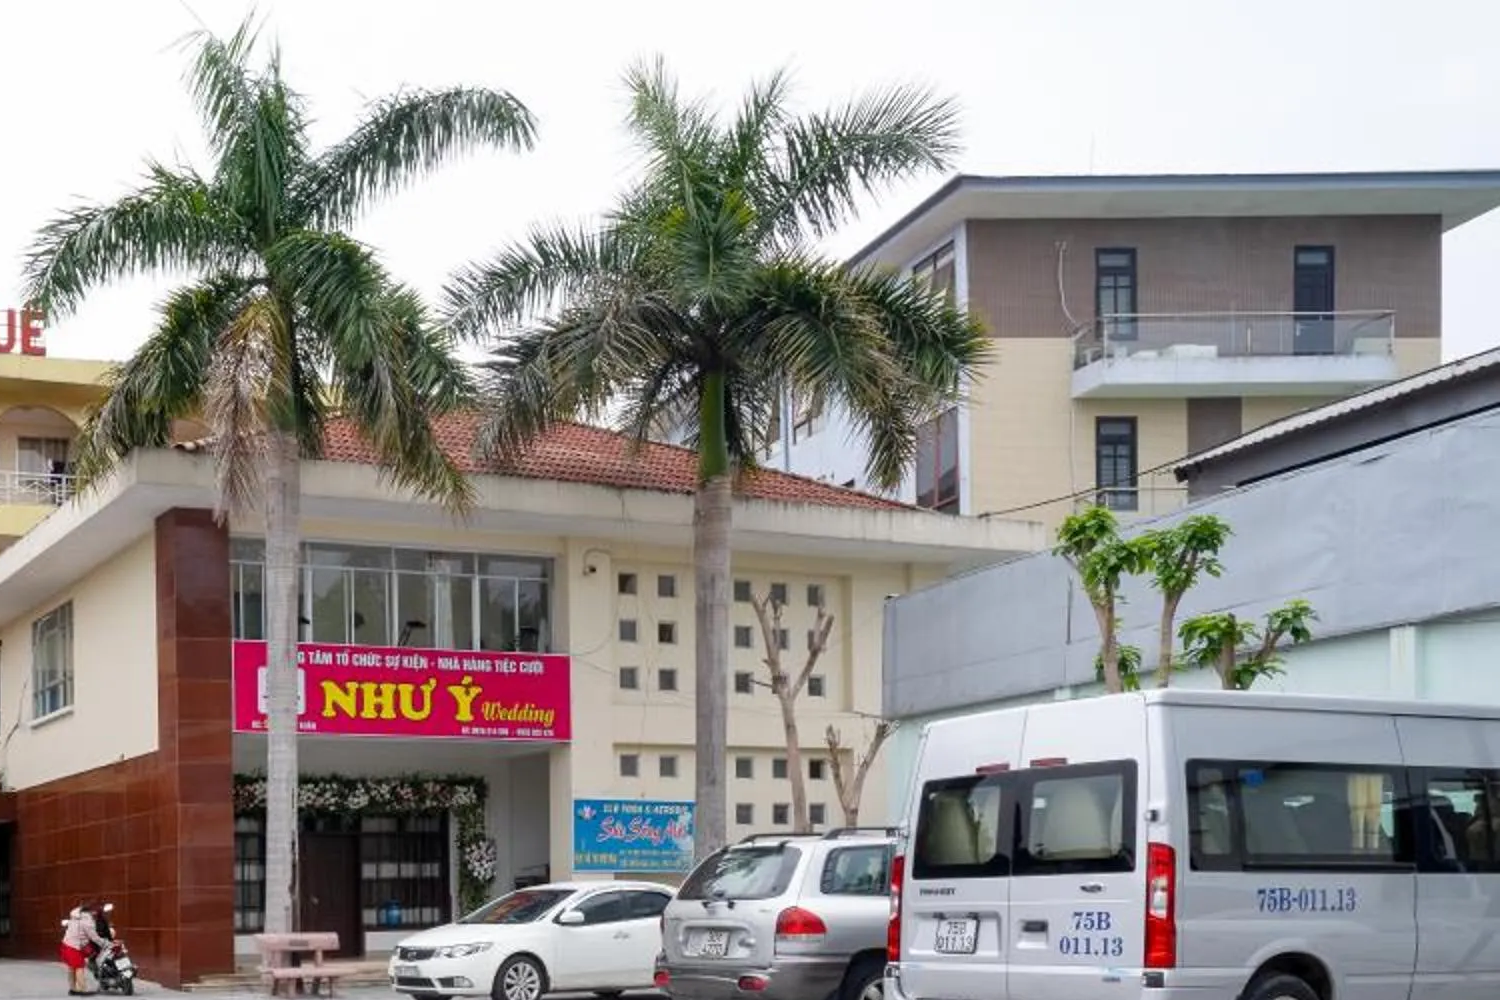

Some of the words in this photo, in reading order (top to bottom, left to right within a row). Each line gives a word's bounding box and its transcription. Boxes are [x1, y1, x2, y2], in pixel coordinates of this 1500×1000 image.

[320, 678, 437, 720] NHƯ
[448, 675, 482, 722] Ý
[481, 701, 555, 727] Wedding
[1257, 886, 1357, 913] 75B-011.13
[1072, 911, 1112, 931] 75B
[1059, 936, 1124, 957] 011.13
